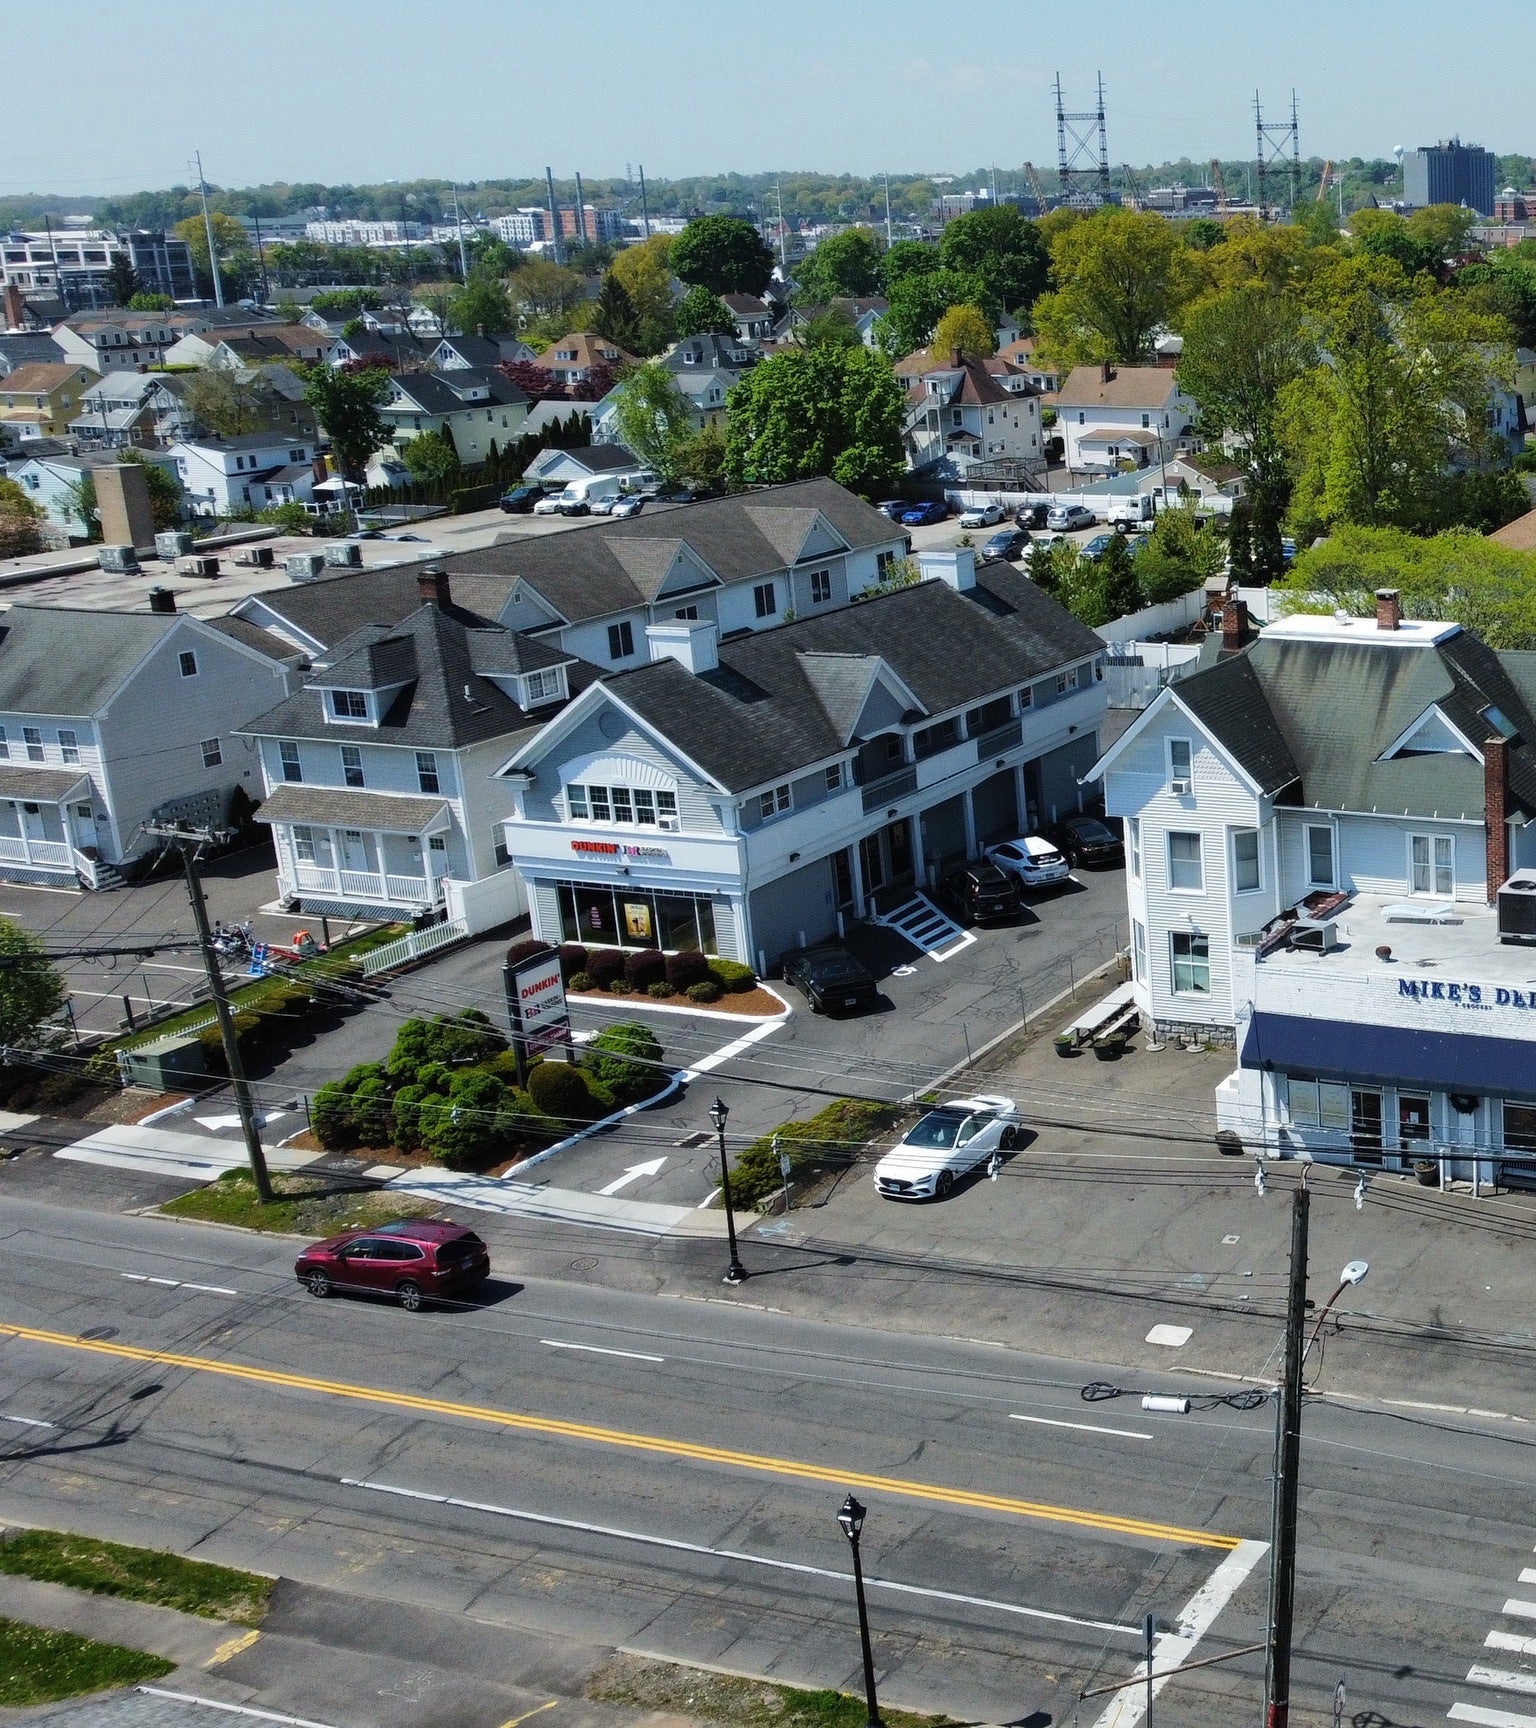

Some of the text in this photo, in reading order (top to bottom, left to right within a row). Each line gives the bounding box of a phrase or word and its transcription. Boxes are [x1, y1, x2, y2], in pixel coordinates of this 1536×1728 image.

[571, 841, 620, 854] DUNKIN'
[521, 972, 560, 999] DUNKIN'
[1398, 978, 1481, 1003] MIKE'S
